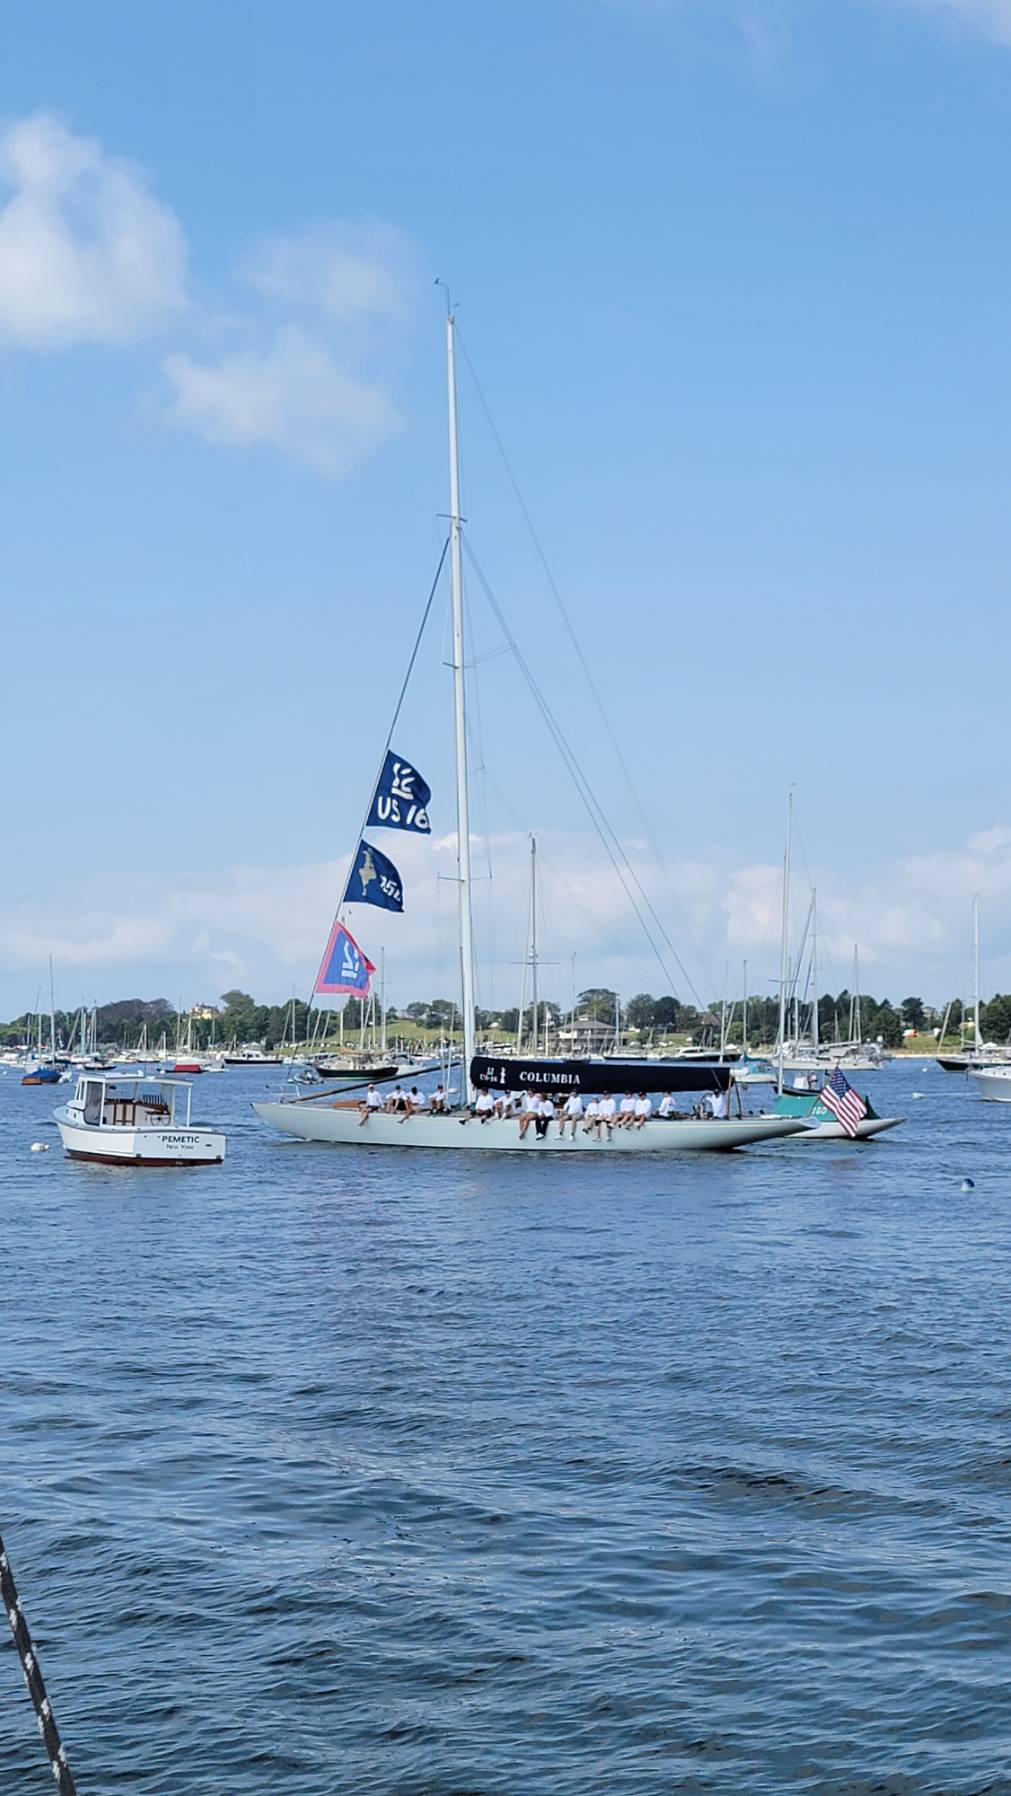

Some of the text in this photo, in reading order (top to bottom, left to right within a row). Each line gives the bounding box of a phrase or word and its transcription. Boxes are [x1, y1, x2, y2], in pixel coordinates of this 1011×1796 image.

[377, 796, 429, 829] US 16
[519, 1071, 581, 1085] COLUMBIA
[162, 1134, 201, 1144] PEMETIC
